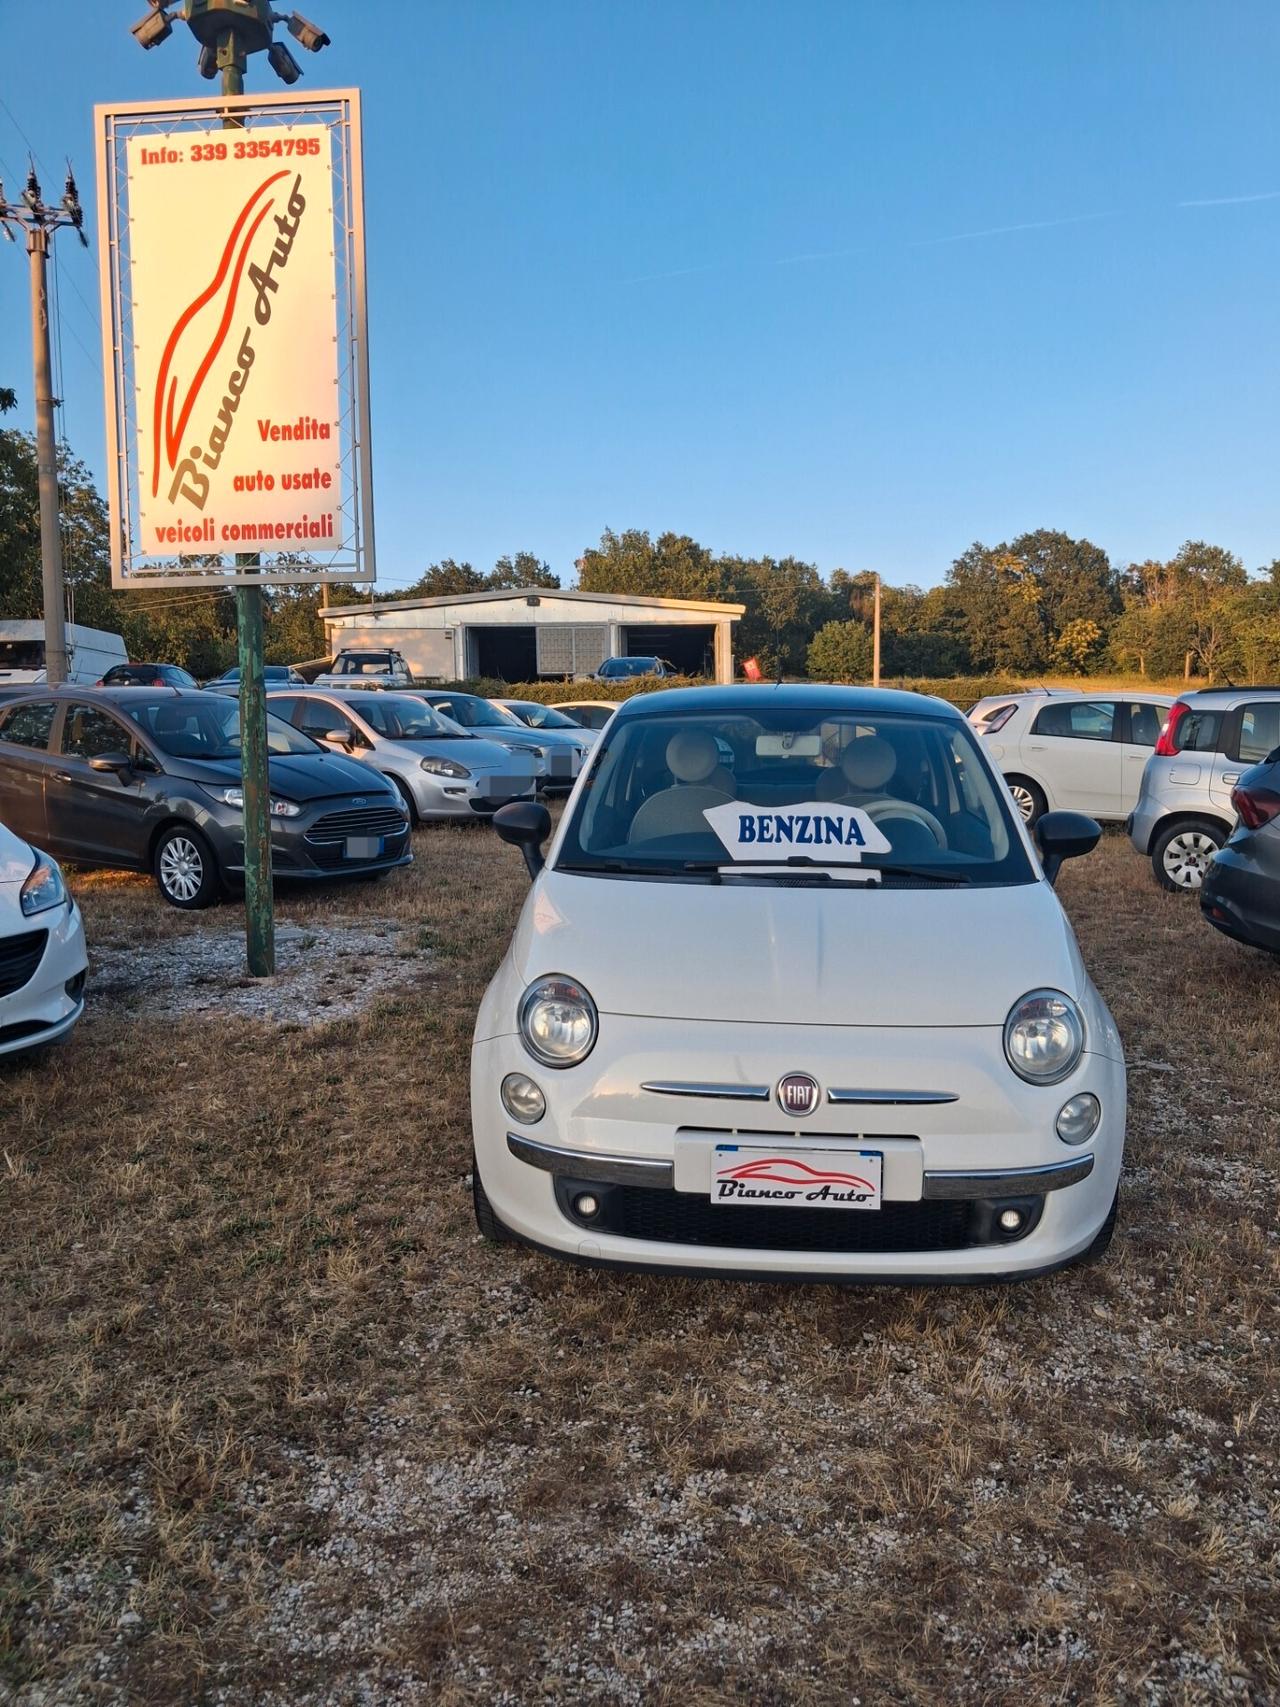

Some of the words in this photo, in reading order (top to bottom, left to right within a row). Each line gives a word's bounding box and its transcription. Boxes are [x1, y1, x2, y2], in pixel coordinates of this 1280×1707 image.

[141, 146, 184, 165] Info:
[190, 143, 228, 162] 339
[233, 138, 320, 158] 3354795
[168, 326, 255, 511] Bianco
[248, 173, 306, 326] Auto
[257, 416, 331, 442] Vendita
[233, 470, 275, 492] auto
[281, 468, 332, 490] usate
[155, 517, 215, 543] veicoli
[221, 514, 333, 541] commerciali
[738, 815, 866, 846] BENZINA
[786, 1085, 811, 1105] FIAT
[716, 1179, 803, 1198] Bianco
[806, 1185, 874, 1203] Auto
